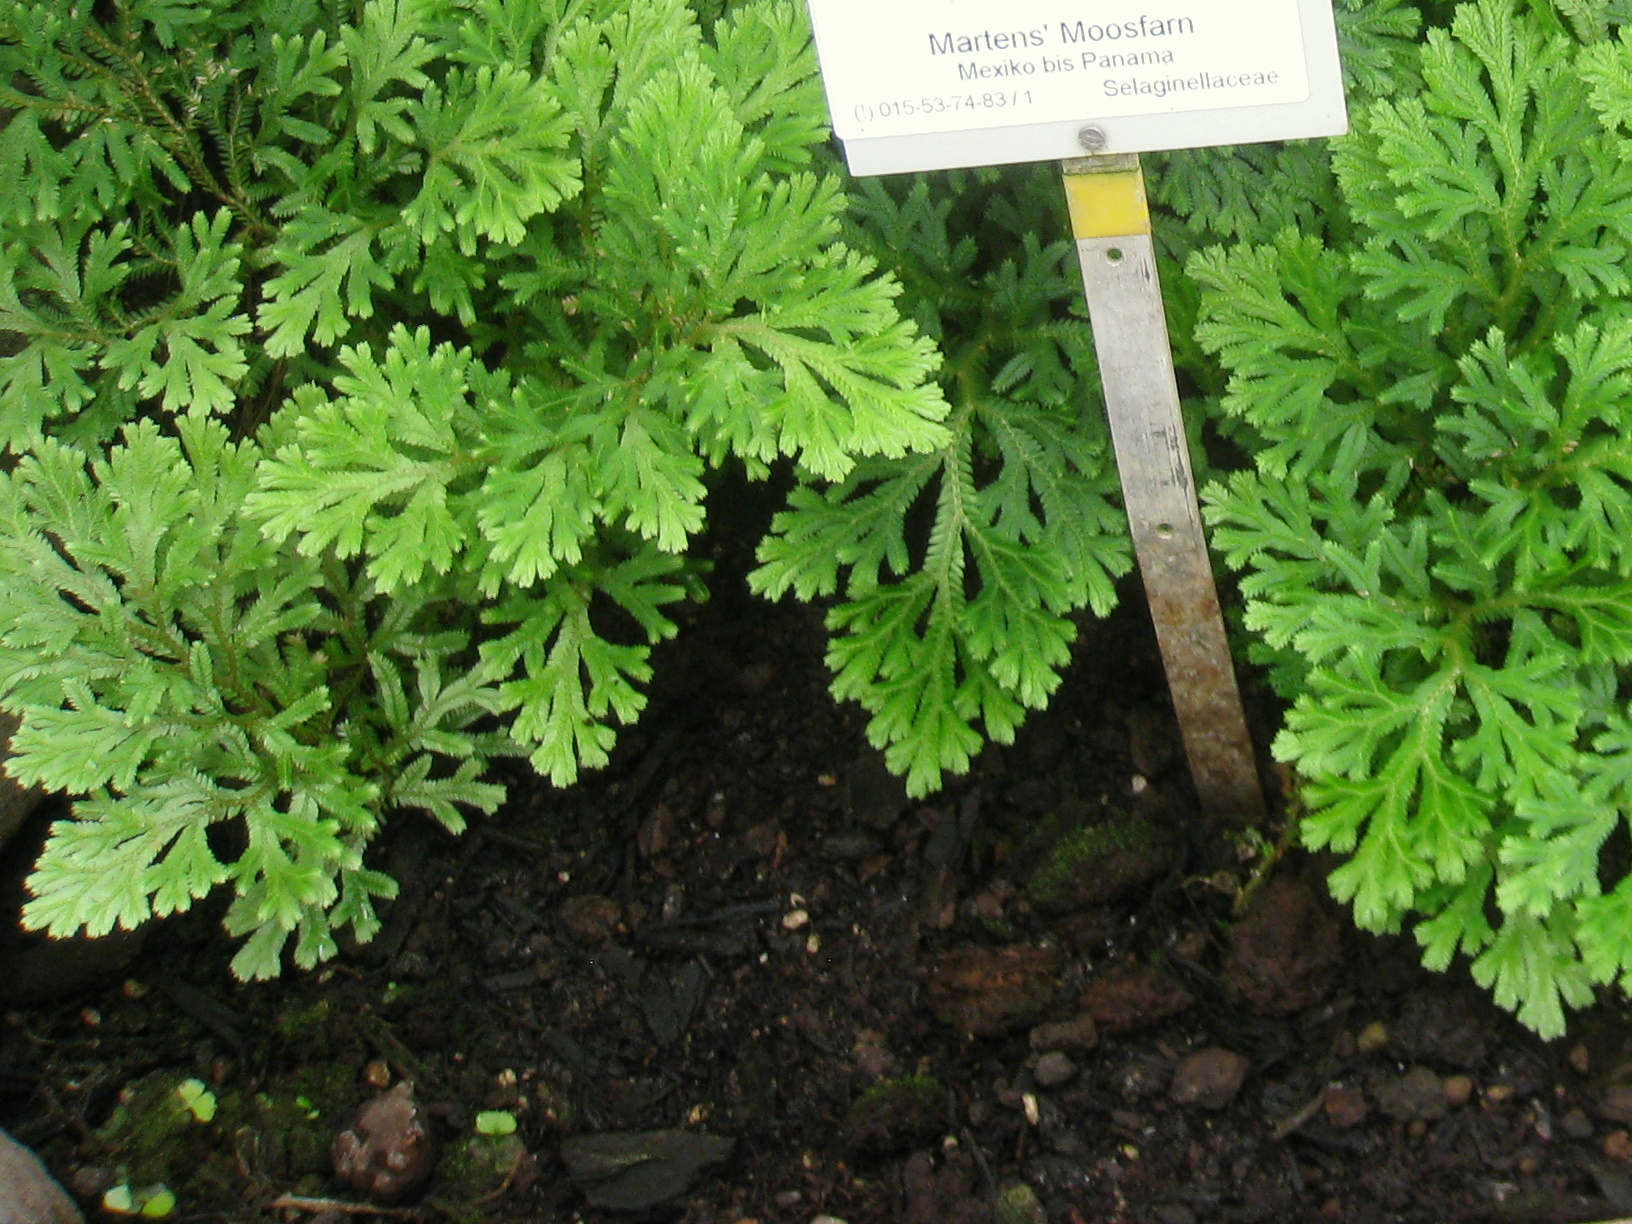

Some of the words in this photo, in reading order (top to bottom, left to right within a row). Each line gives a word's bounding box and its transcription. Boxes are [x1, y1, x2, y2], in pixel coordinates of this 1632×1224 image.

[928, 23, 1049, 56] Martens'
[1060, 13, 1195, 45] Moosfarn
[957, 60, 1036, 81] Mexiko
[1042, 55, 1075, 74] bis
[1081, 48, 1174, 71] Panama
[1102, 69, 1280, 100] Selaginellaceae
[879, 92, 1007, 117] 015-53-74-83
